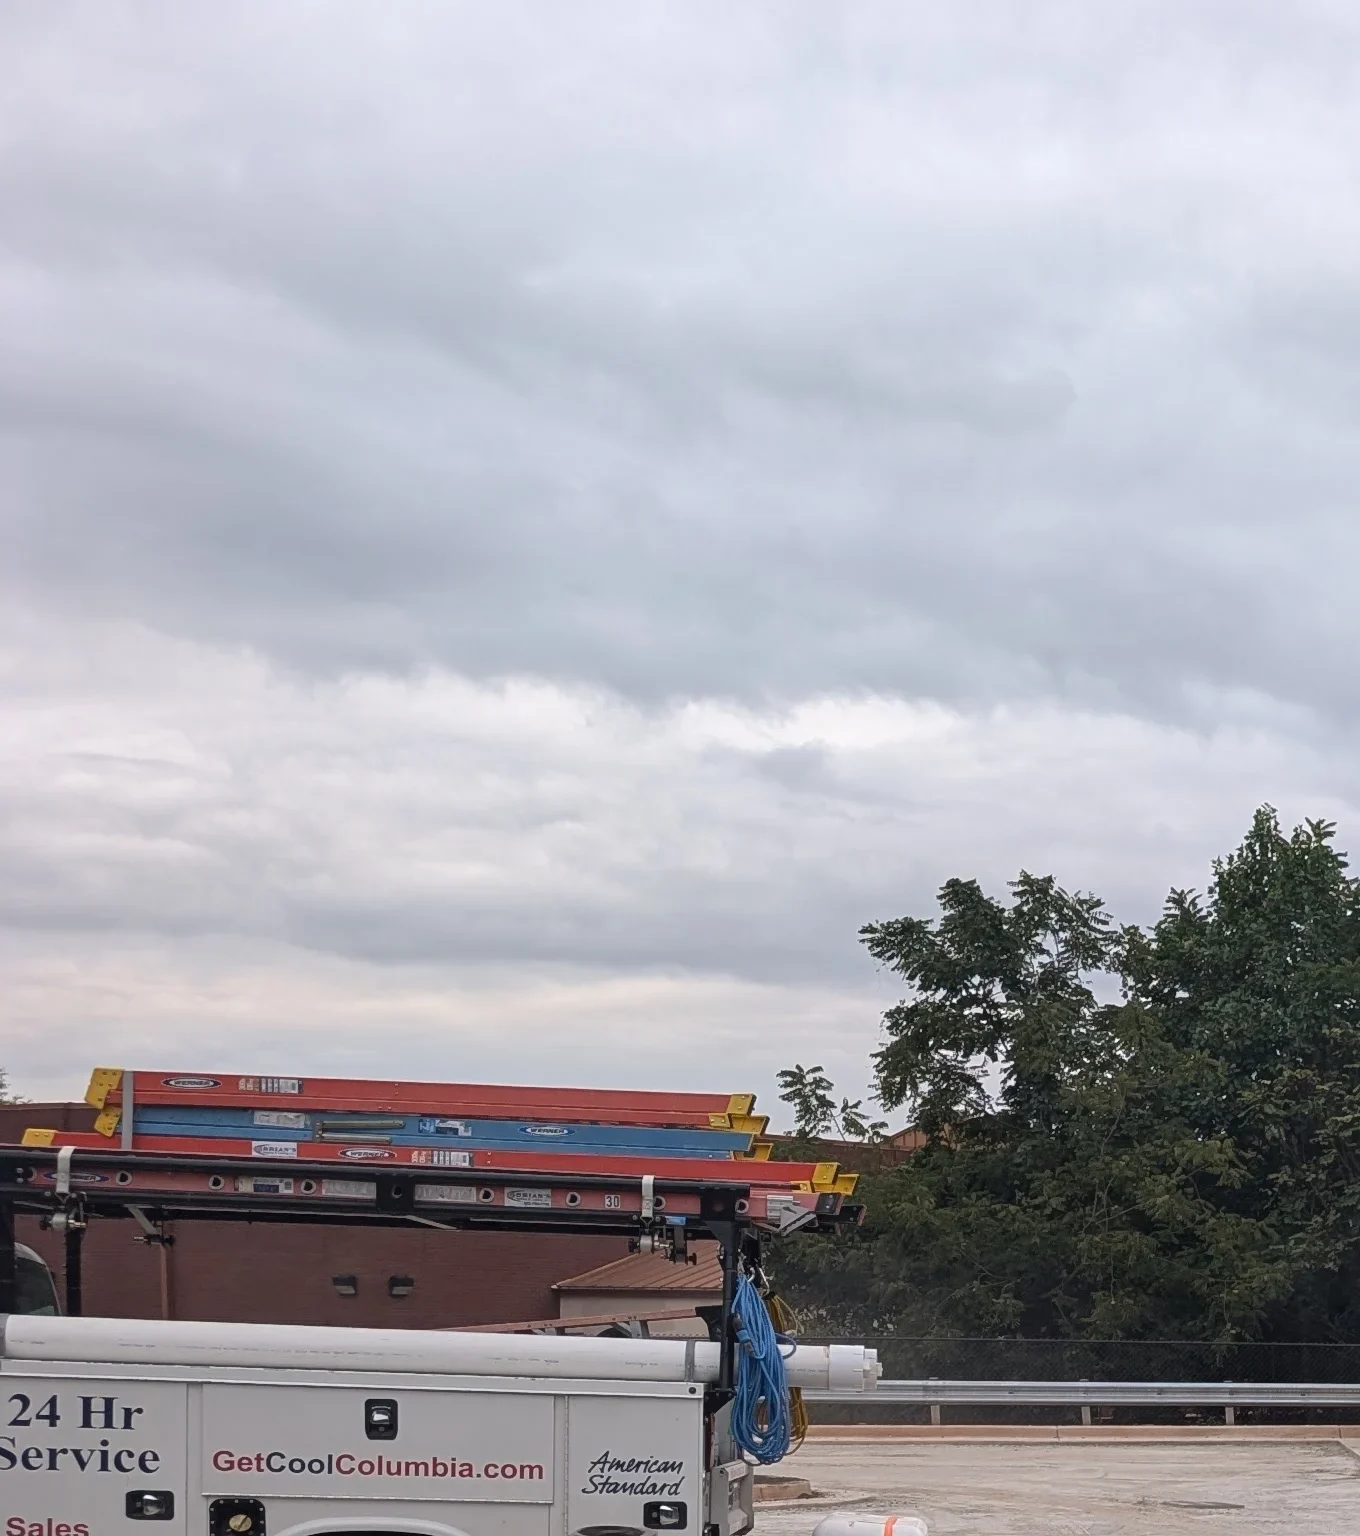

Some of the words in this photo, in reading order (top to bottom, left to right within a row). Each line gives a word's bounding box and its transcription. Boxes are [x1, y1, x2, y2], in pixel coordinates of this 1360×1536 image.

[605, 1195, 620, 1208] 30
[7, 1393, 61, 1428] 24
[77, 1395, 144, 1431] Hr
[0, 1435, 161, 1475] Service
[212, 1450, 544, 1480] GetCoolColumbia.com
[587, 1450, 684, 1475] American
[581, 1474, 686, 1496] Standard
